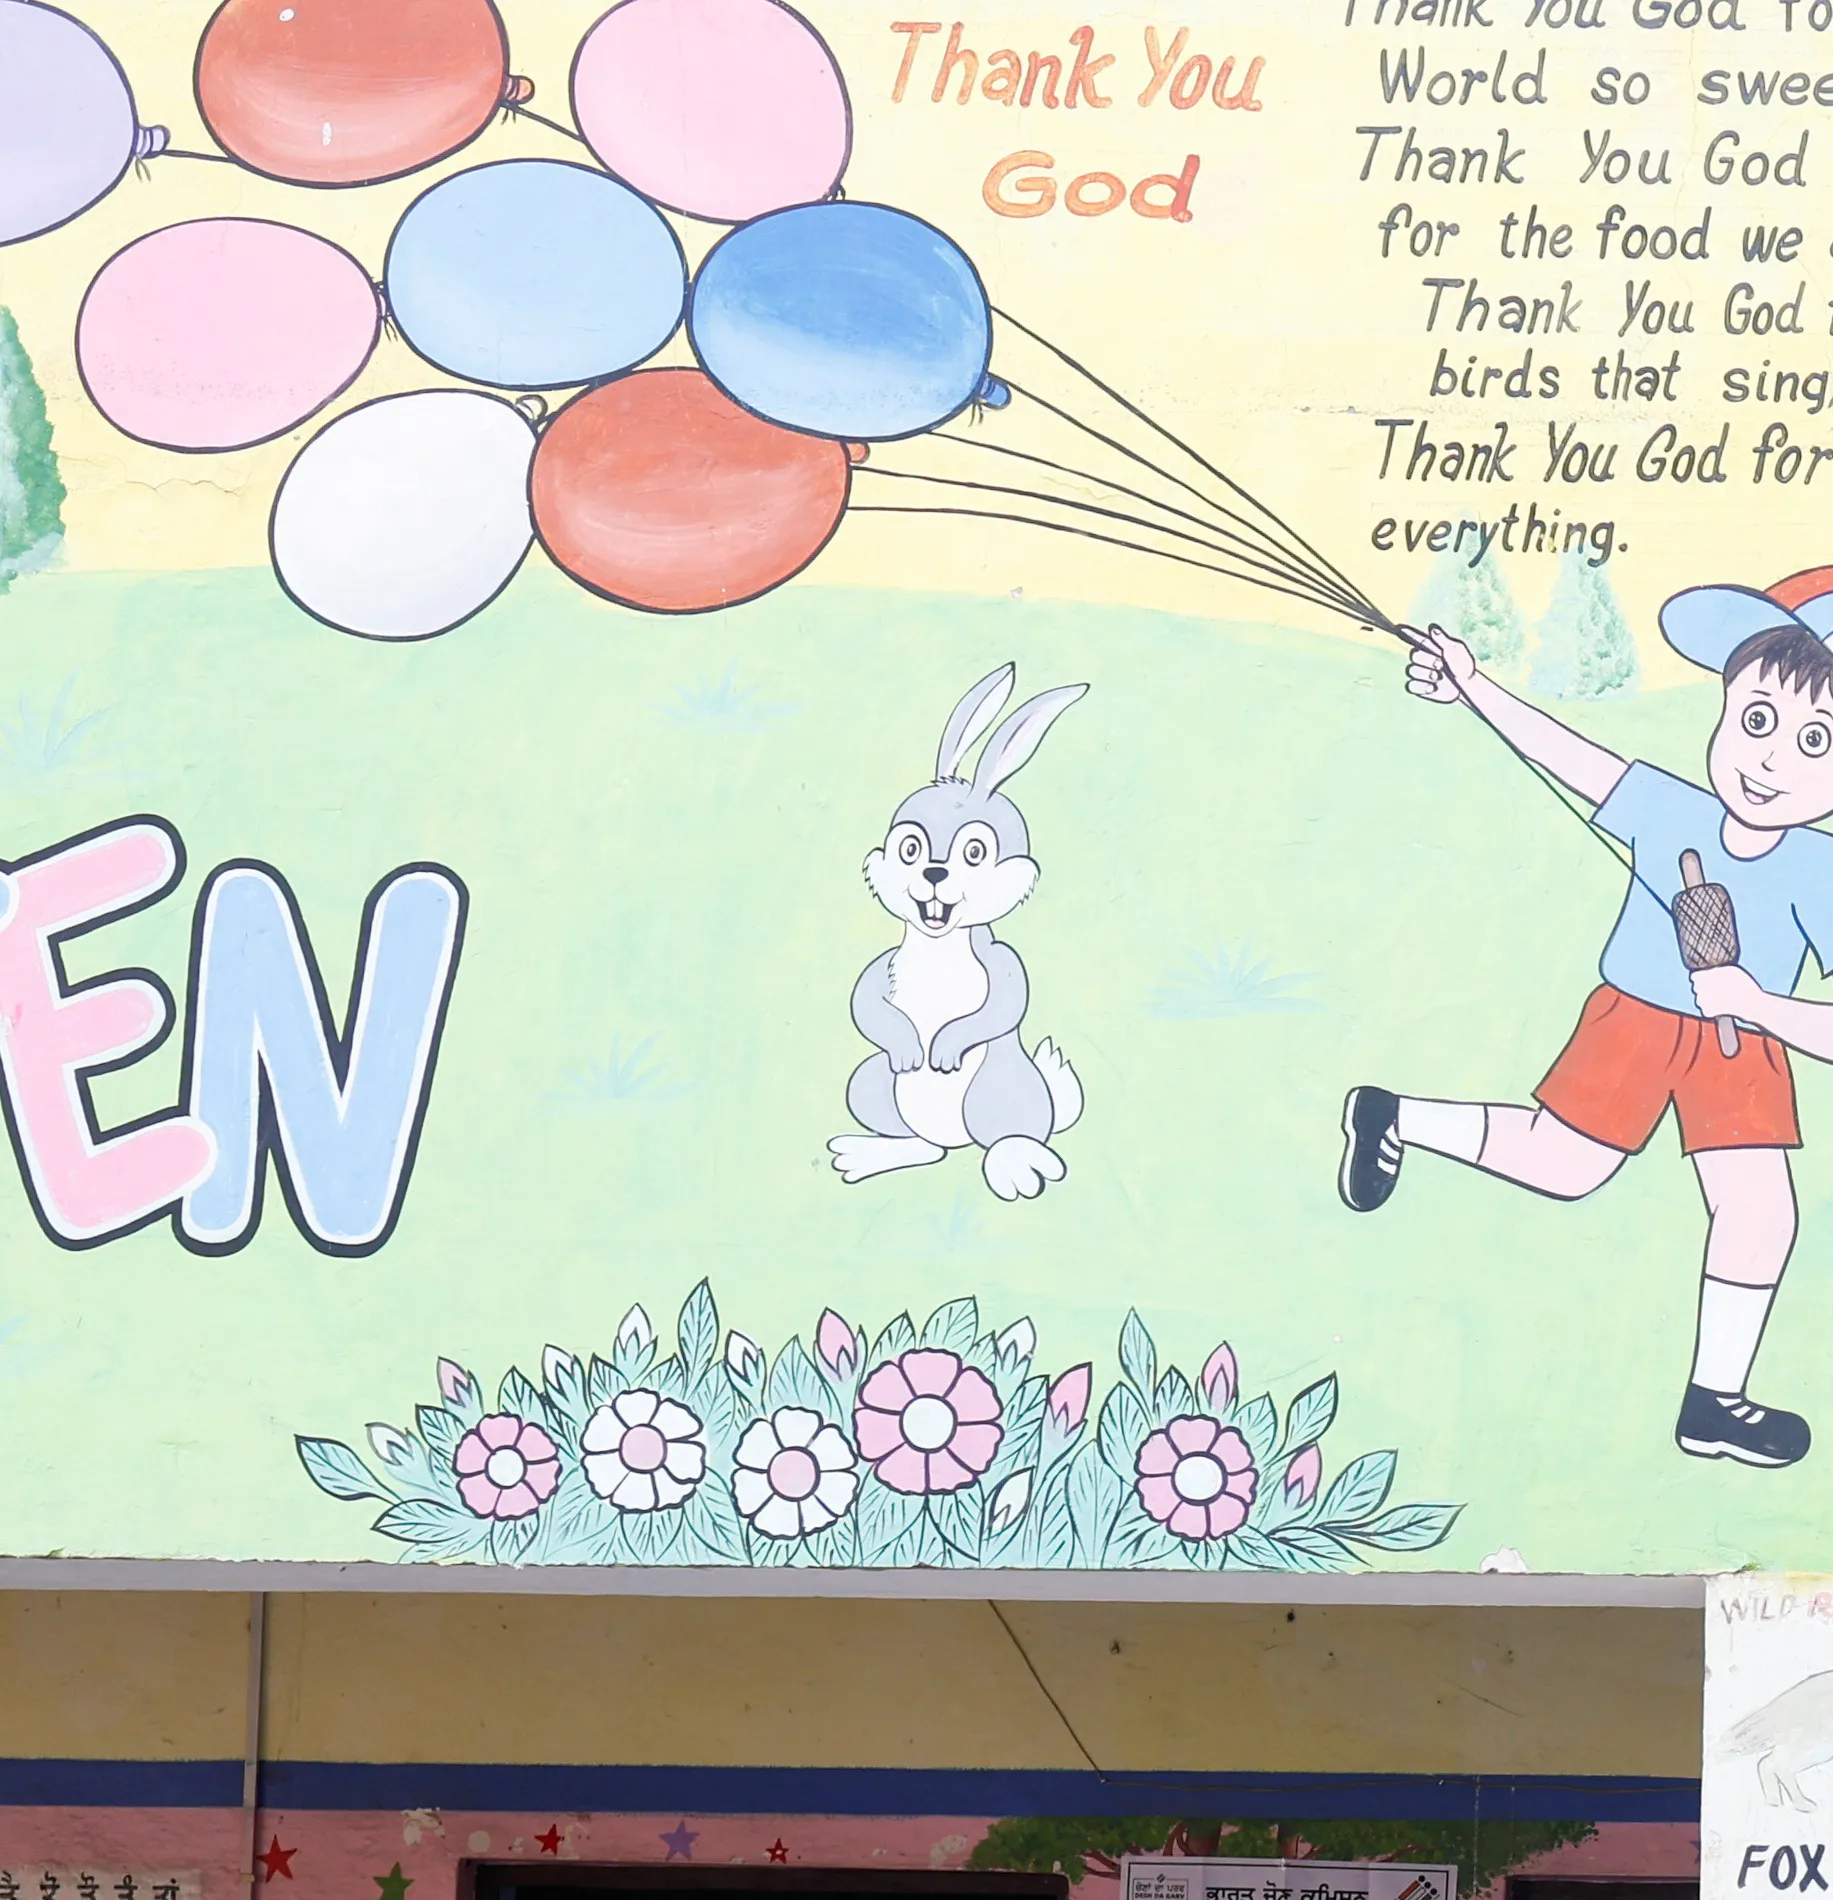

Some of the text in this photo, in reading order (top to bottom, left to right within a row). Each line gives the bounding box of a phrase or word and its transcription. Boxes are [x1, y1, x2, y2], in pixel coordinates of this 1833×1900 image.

[889, 22, 1268, 114] Thank You
[1380, 46, 1548, 105] World
[1591, 66, 1651, 105] so
[981, 150, 1200, 224] God
[1356, 126, 1809, 187] Thank You God
[1378, 203, 1460, 258] for
[1500, 204, 1574, 259] the
[1596, 204, 1712, 260] food
[1742, 225, 1804, 263] we
[1422, 277, 1582, 333] Thank
[1617, 279, 1696, 336] You
[1723, 280, 1805, 336] God
[1429, 348, 1561, 399] birds
[1591, 348, 1681, 402] that
[1373, 418, 1515, 482] Thank
[1543, 420, 1618, 484] You
[1635, 422, 1730, 485] God
[1370, 502, 1629, 568] everything.
[0, 813, 471, 1258] EN
[1737, 1844, 1828, 1893] FOX
